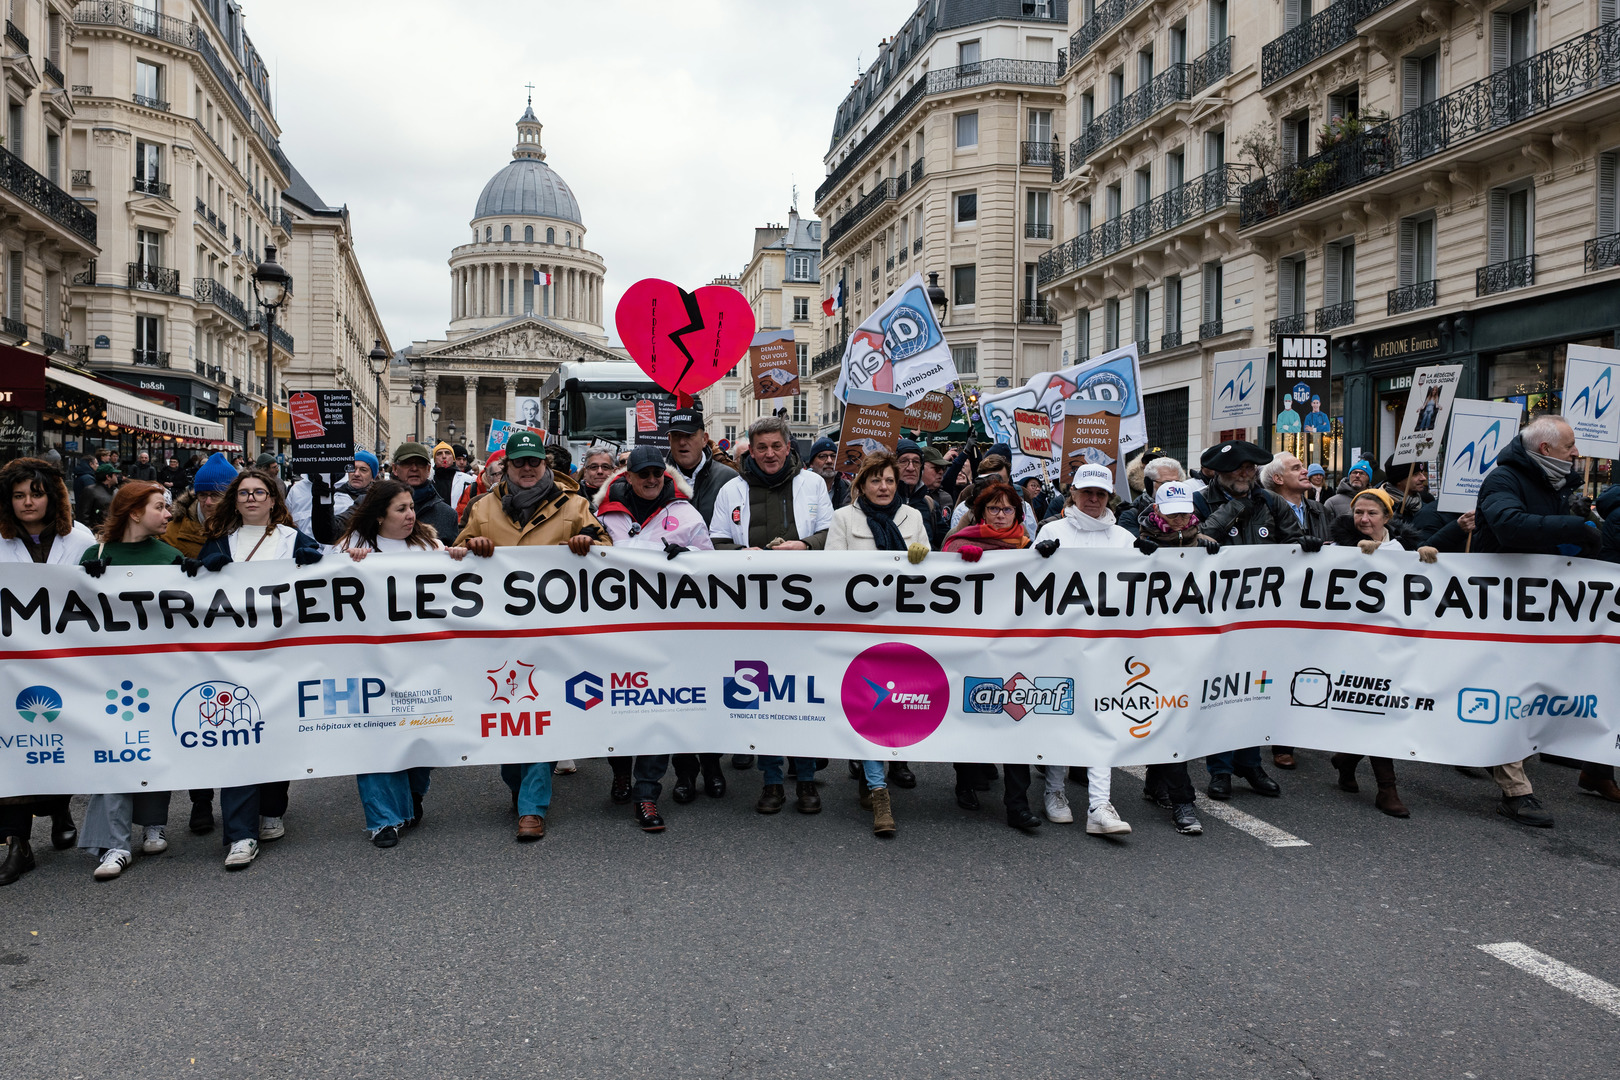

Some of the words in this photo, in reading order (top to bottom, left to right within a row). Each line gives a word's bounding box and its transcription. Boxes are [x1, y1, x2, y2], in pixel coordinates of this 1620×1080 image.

[712, 311, 724, 368] MACRON
[760, 345, 785, 353] DEMAIN,
[1282, 338, 1327, 358] MIB
[760, 353, 771, 361] QUI
[772, 351, 788, 359] VOUS
[758, 360, 787, 369] SOIGNERA
[1282, 359, 1298, 368] MEN
[1299, 359, 1307, 368] IN
[1308, 359, 1327, 368] BLOC
[1286, 370, 1296, 378] EN
[1297, 370, 1322, 378] COLERE
[140, 381, 165, 391] ba&sh
[925, 394, 944, 403] SANS
[1293, 392, 1310, 402] BLOC
[860, 408, 889, 419] DEMAIN,
[904, 408, 921, 418] OINS
[923, 411, 942, 421] SANS
[136, 414, 149, 428] LE
[153, 418, 206, 437] SOUFFLOT
[857, 417, 870, 426] QUI
[871, 419, 891, 428] VOUS
[1077, 418, 1107, 426] DEMAIN,
[851, 427, 887, 438] SOIGNERA
[1030, 427, 1048, 438] POUR
[1076, 427, 1089, 435] QUI
[0, 575, 366, 637] MALTRAITER
[386, 572, 484, 621] LES
[845, 572, 995, 615] C'EST
[1014, 566, 1286, 617] MALTRAITER
[1300, 567, 1388, 614] LES
[611, 671, 649, 689] MG
[1334, 672, 1392, 691] JEUNES
[297, 677, 386, 718] FHP
[391, 689, 431, 698] FÉDÉRATION
[611, 687, 706, 706] FRANCE
[891, 692, 931, 704] UFML
[974, 682, 1069, 711] anemf
[391, 695, 453, 706] L'HOSPITALISATION
[391, 705, 415, 713] PRIVÉE
[770, 713, 798, 721] MÉDECINS
[298, 724, 314, 732] Des
[316, 722, 351, 732] hôpitaux
[364, 720, 396, 729] cliniques
[398, 717, 406, 726] à
[409, 714, 454, 726] missions
[481, 710, 552, 738] FMF
[124, 730, 150, 745] LE
[180, 721, 265, 748] csmf
[0, 733, 64, 749] VENIR
[26, 747, 65, 764] SPÉ
[94, 748, 152, 764] BLOC
